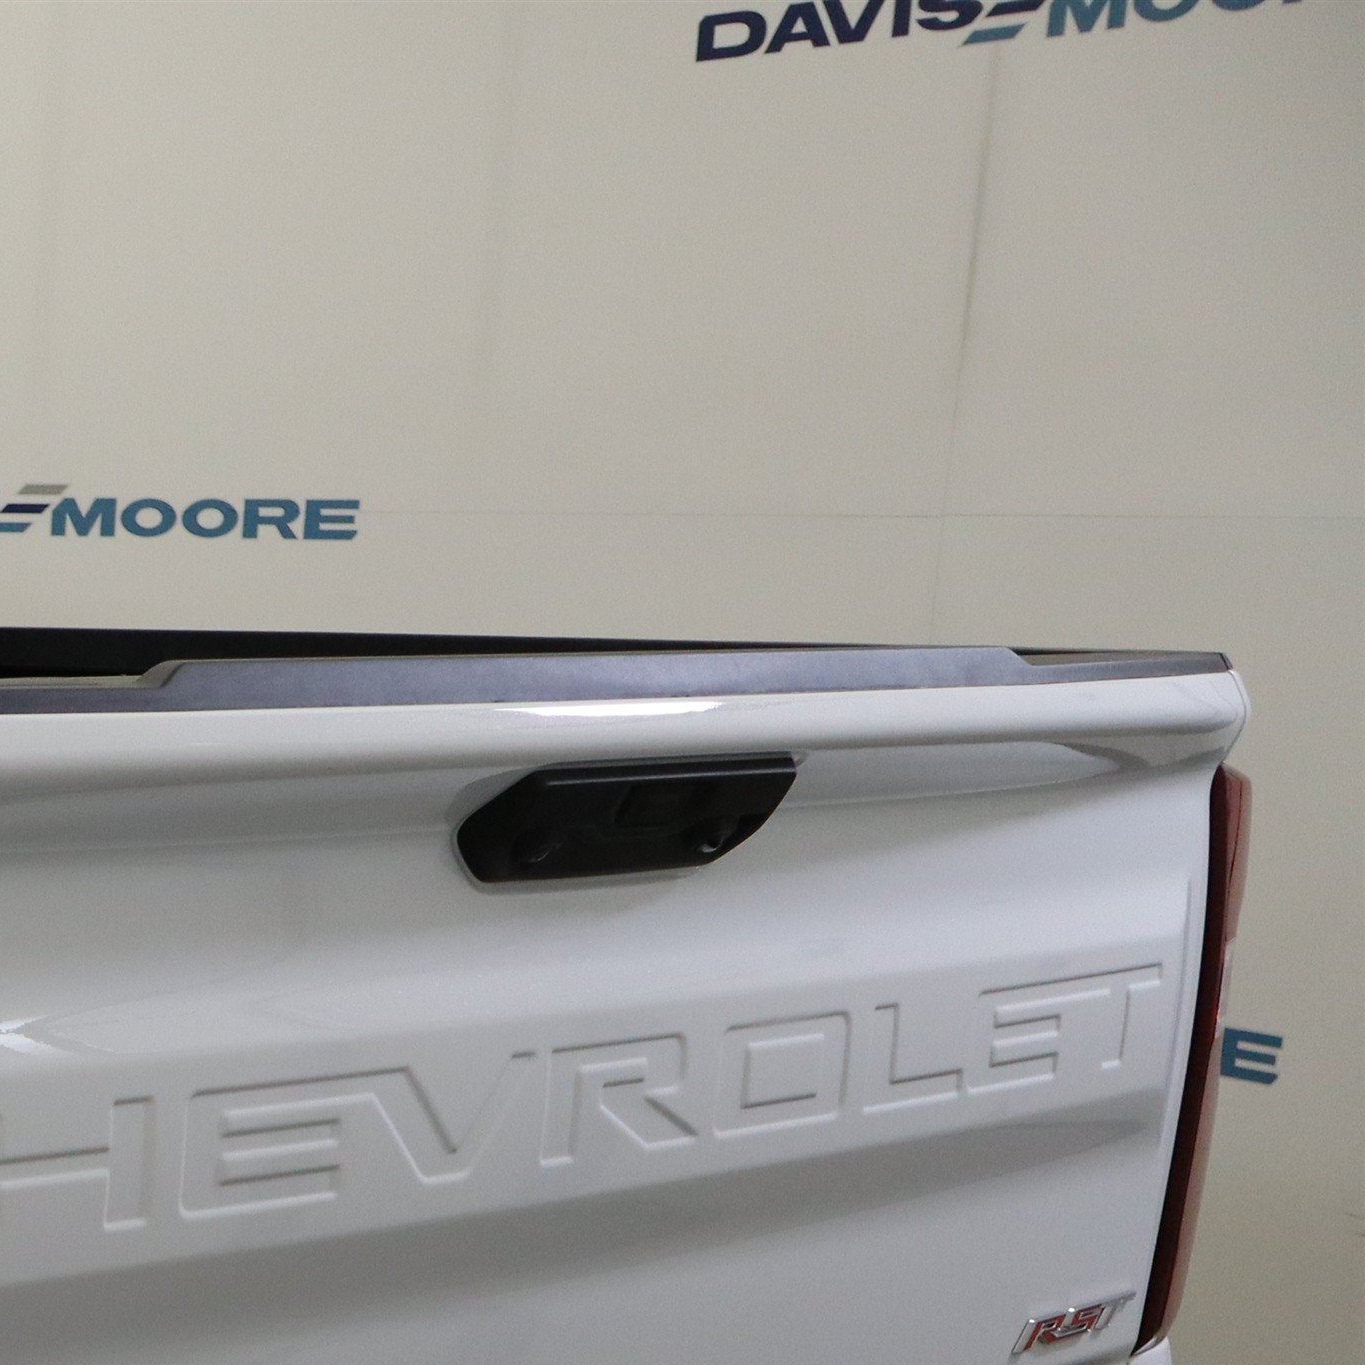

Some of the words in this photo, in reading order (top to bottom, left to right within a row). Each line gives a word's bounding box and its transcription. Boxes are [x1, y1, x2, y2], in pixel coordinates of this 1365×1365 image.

[695, 0, 971, 62] DAVIS
[50, 497, 361, 541] MOORE
[1012, 1292, 1137, 1355] RST
